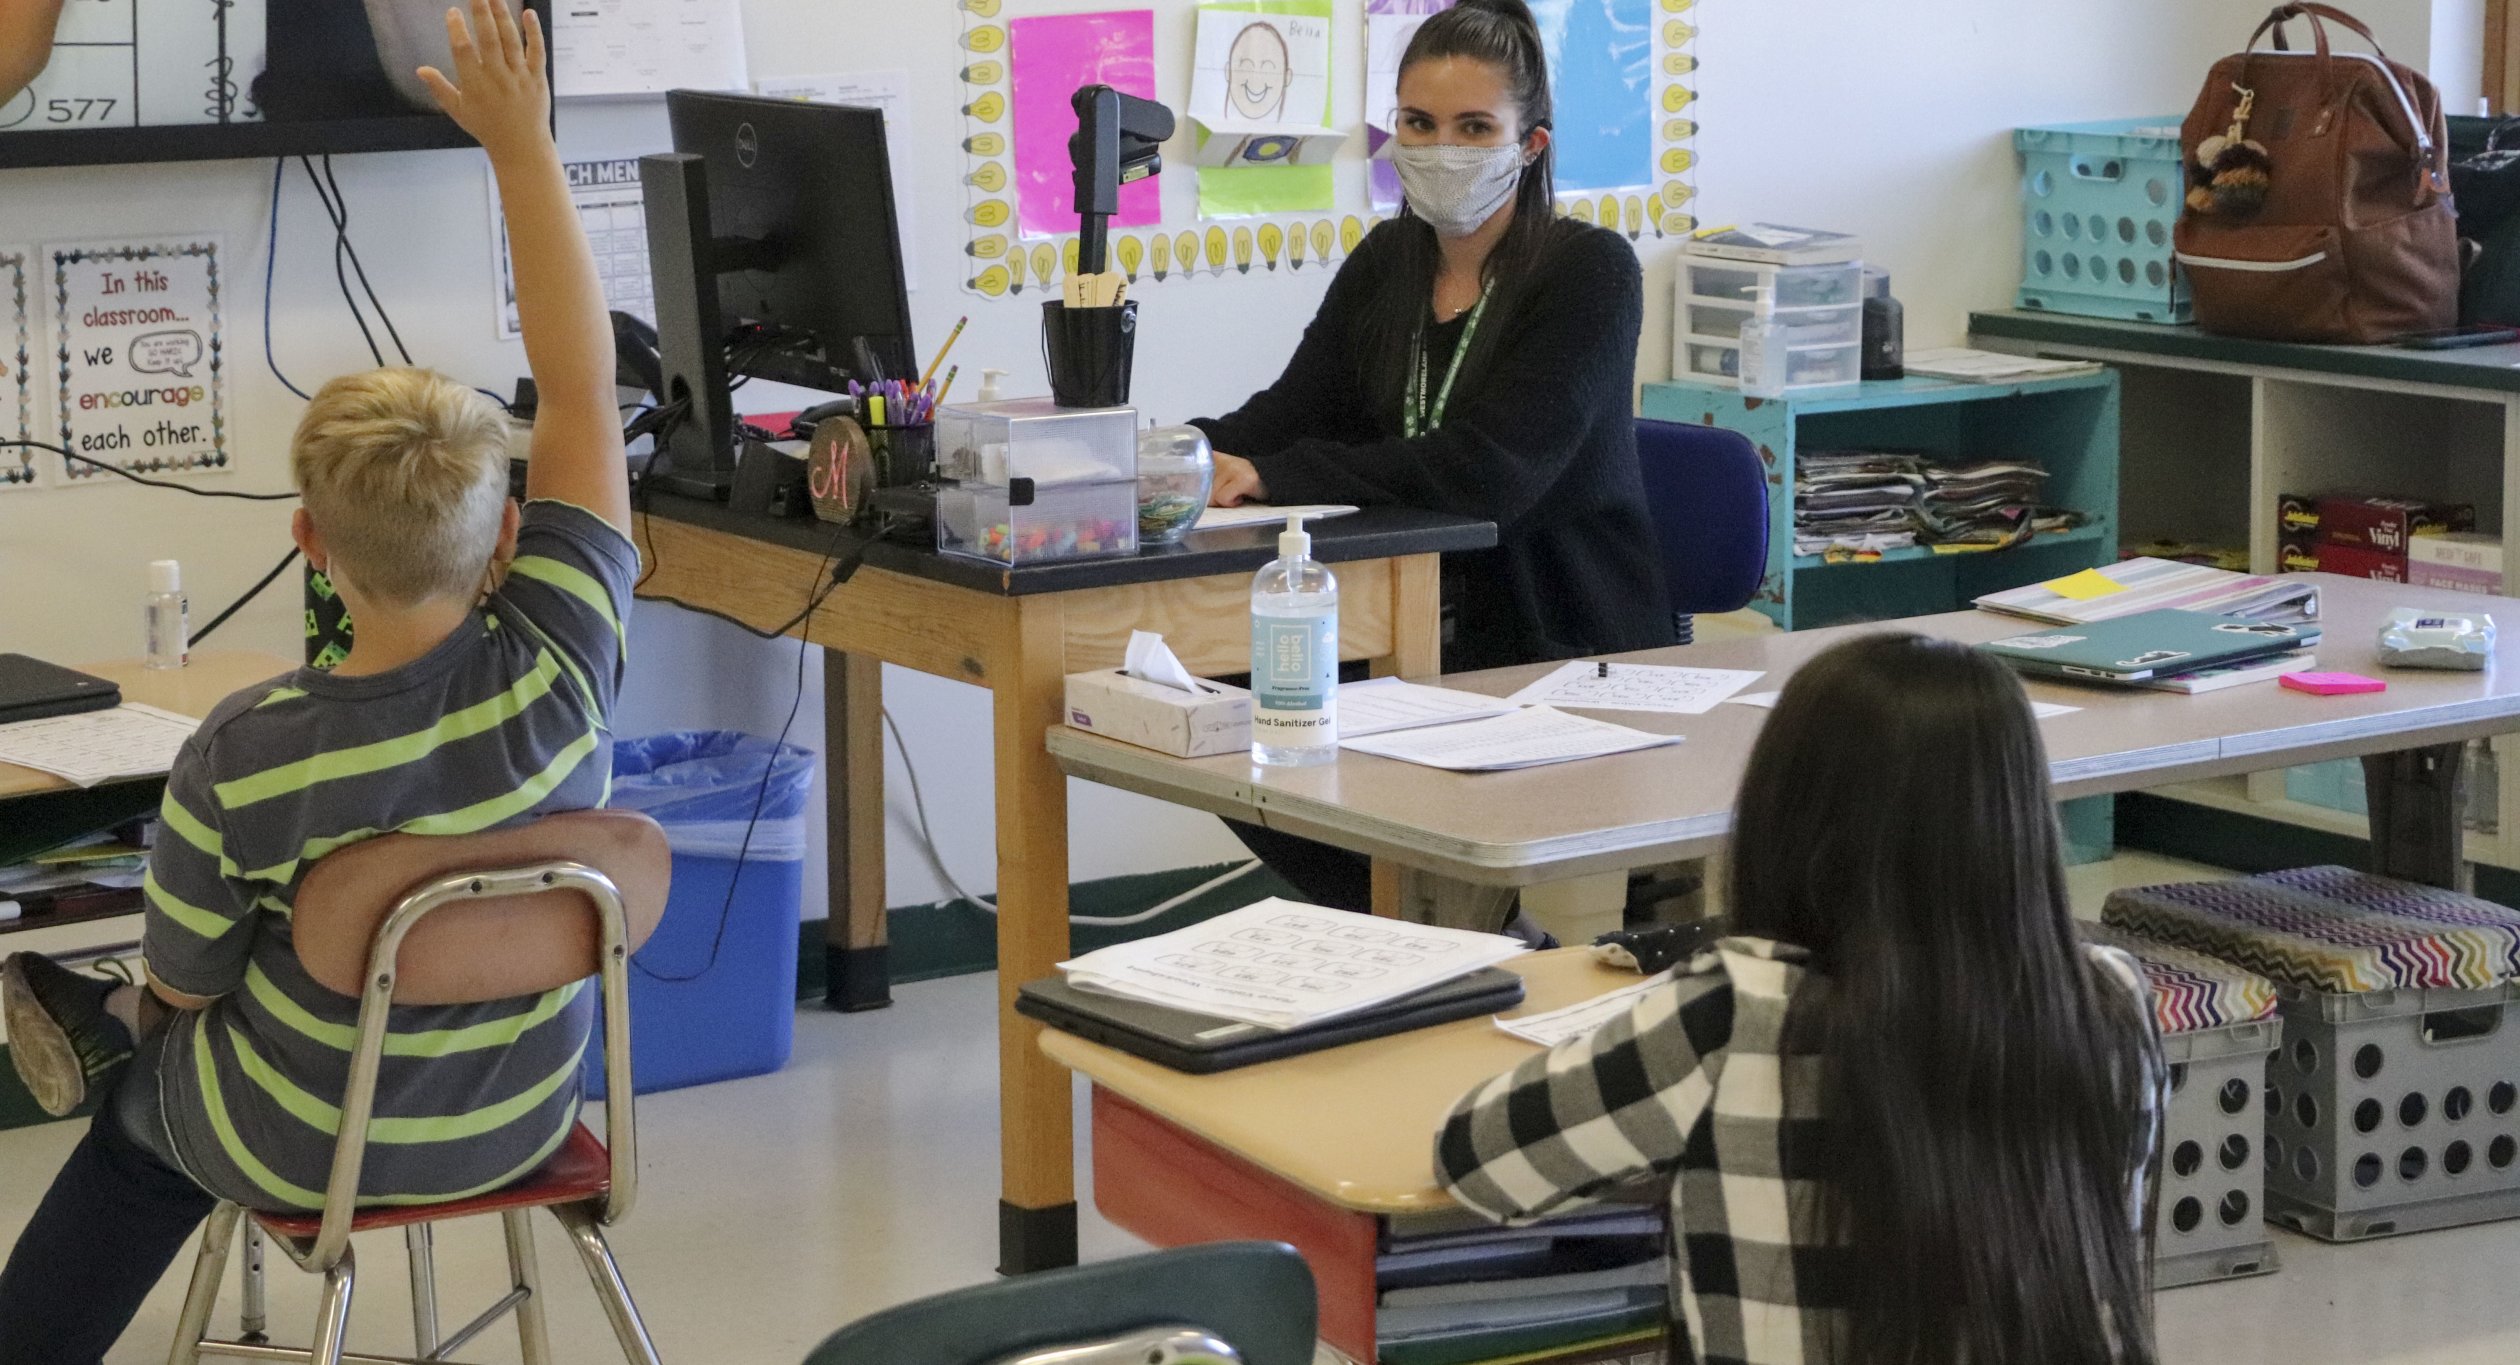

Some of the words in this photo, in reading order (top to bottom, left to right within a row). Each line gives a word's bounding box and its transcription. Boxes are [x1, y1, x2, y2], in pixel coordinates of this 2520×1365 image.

[47, 99, 117, 123] 577
[597, 160, 639, 182] MEN
[101, 273, 125, 294] In
[134, 271, 169, 292] this
[83, 306, 190, 327] classroom...
[84, 347, 114, 366] we
[79, 385, 205, 409] encourage
[82, 424, 131, 451] each
[143, 421, 207, 447] other.
[812, 440, 849, 510] M
[2368, 527, 2400, 550] Vinyl
[1277, 635, 1290, 672] hello
[1255, 715, 1272, 726] Hand
[1274, 717, 1316, 728] Sanitizer
[1318, 716, 1331, 726] Gel
